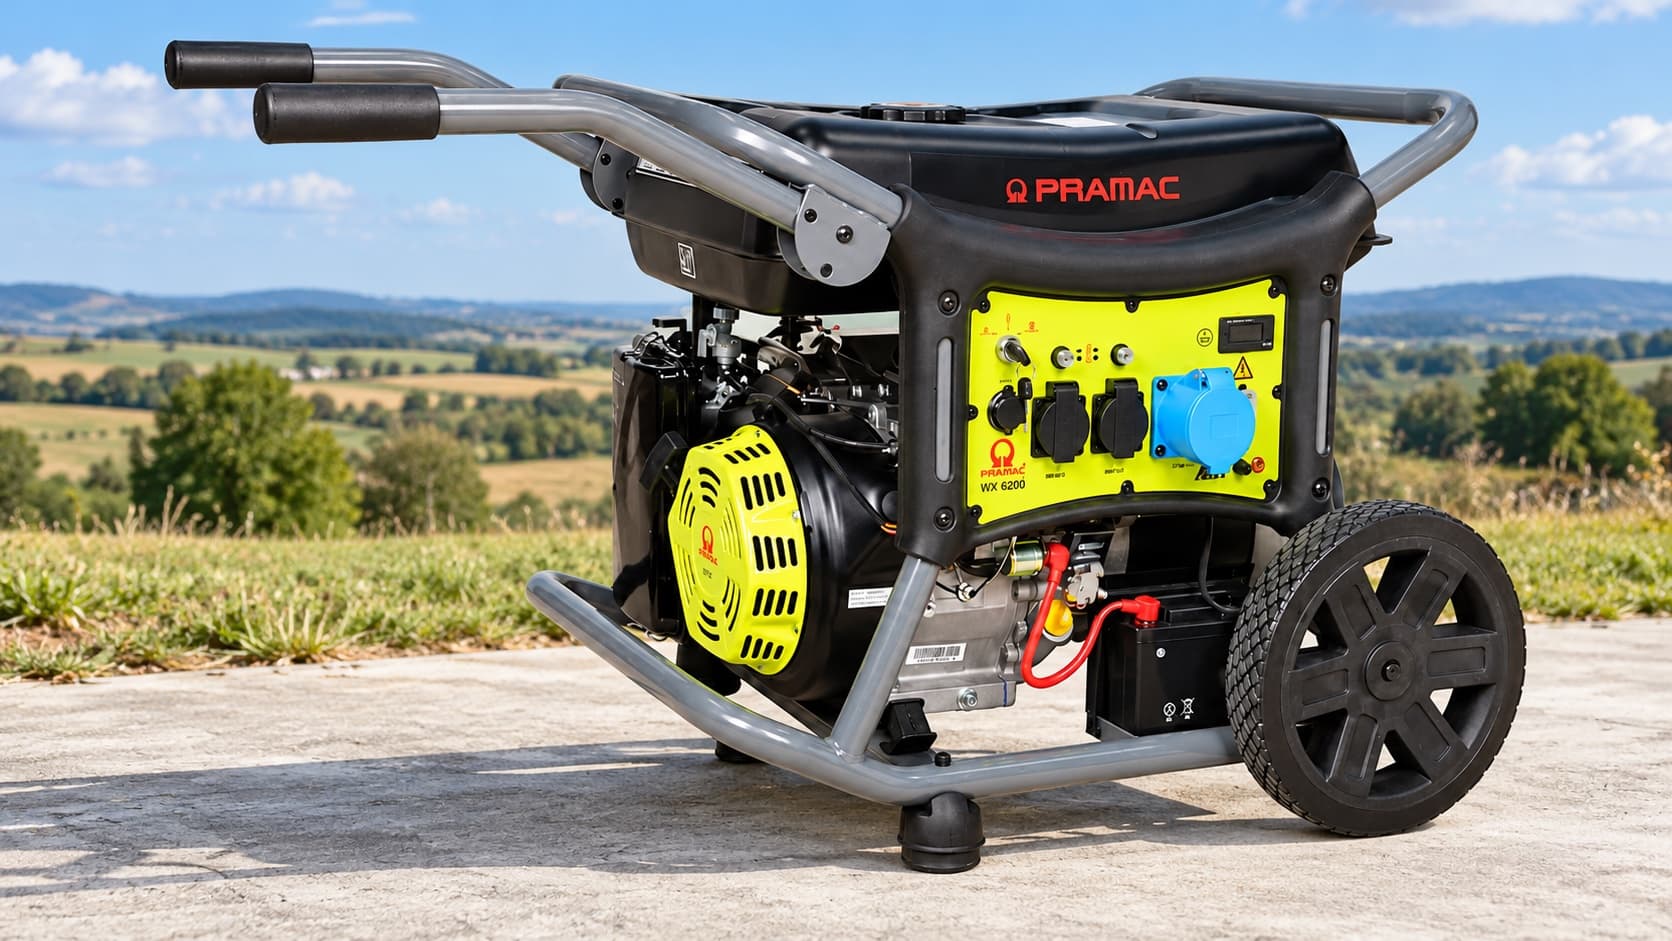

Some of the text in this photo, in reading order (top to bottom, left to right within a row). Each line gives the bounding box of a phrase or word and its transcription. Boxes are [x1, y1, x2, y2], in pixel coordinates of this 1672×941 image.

[1036, 176, 1181, 203] PRAMAC
[980, 466, 1025, 478] PRAMAC
[980, 479, 1026, 493] WX 6200
